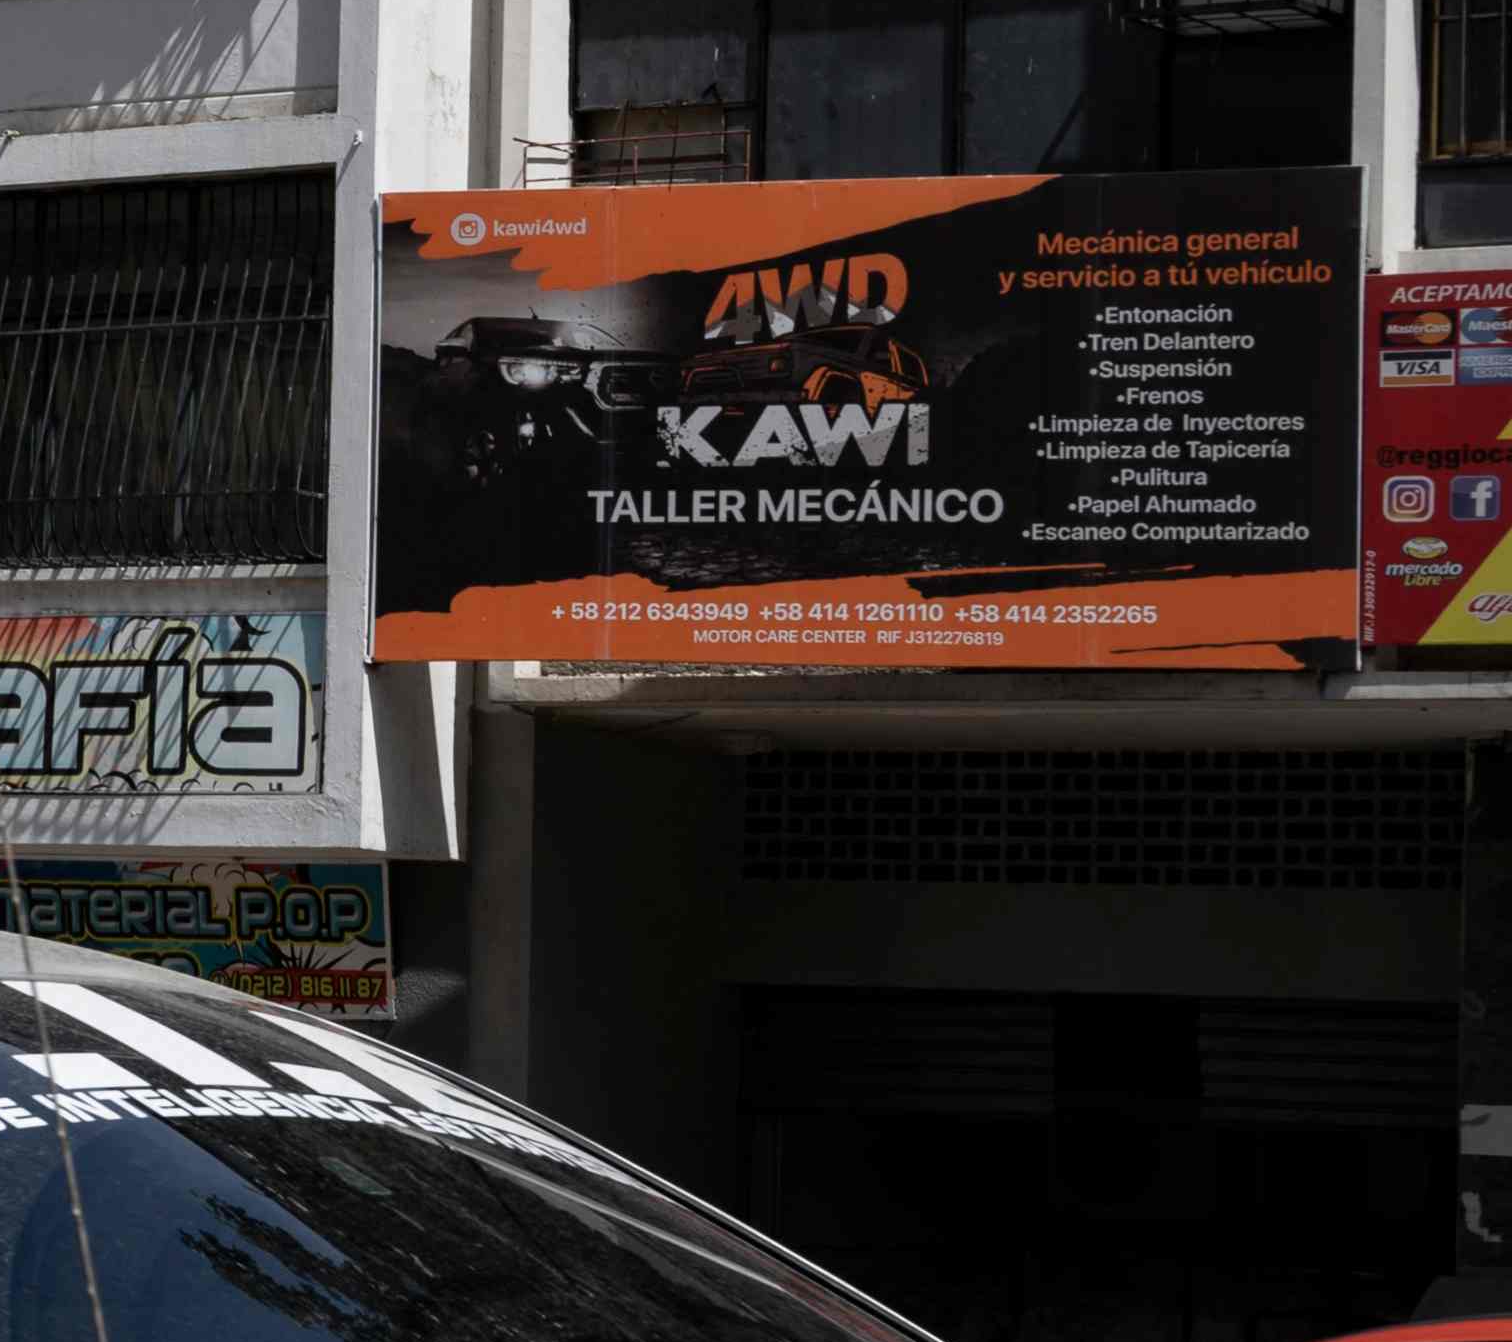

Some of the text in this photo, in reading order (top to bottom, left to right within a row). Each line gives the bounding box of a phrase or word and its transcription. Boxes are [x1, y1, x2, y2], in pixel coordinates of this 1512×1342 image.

[493, 218, 587, 238] kawi4wd
[1038, 227, 1299, 257] Mecánica general
[999, 259, 1332, 295] y servicio a tú vehículo
[704, 253, 909, 345] 4WD
[1104, 304, 1233, 325] Entonación
[1087, 331, 1255, 352] Tren Delantero
[1099, 359, 1233, 382] Suspensión
[1395, 361, 1441, 376] VISA
[1125, 387, 1205, 405] Frenos
[656, 403, 930, 467] KAWI
[1038, 413, 1305, 436] Limpieza de Inyectores
[1046, 439, 1291, 464] Limpieza de Tapicería
[1120, 468, 1209, 486] Pulitura
[587, 480, 1005, 524] TALLER MECÁNICO
[1077, 494, 1257, 517] Papel Ahumado
[1031, 521, 1310, 544] Escaneo Computarizado
[1384, 560, 1465, 576] mercado
[570, 602, 599, 620] 58
[603, 602, 642, 621] 212
[646, 602, 749, 621] 6343949
[760, 603, 802, 621] +58
[807, 603, 849, 621] 414
[855, 603, 944, 622] 1261110
[954, 604, 1000, 623] +58
[1004, 604, 1048, 623] 414
[1053, 605, 1159, 625] 2352265
[693, 629, 1005, 646] MOTOR CARE CENTER RIF J312276819
[32, 1087, 410, 1129] INTELIGENCIA
